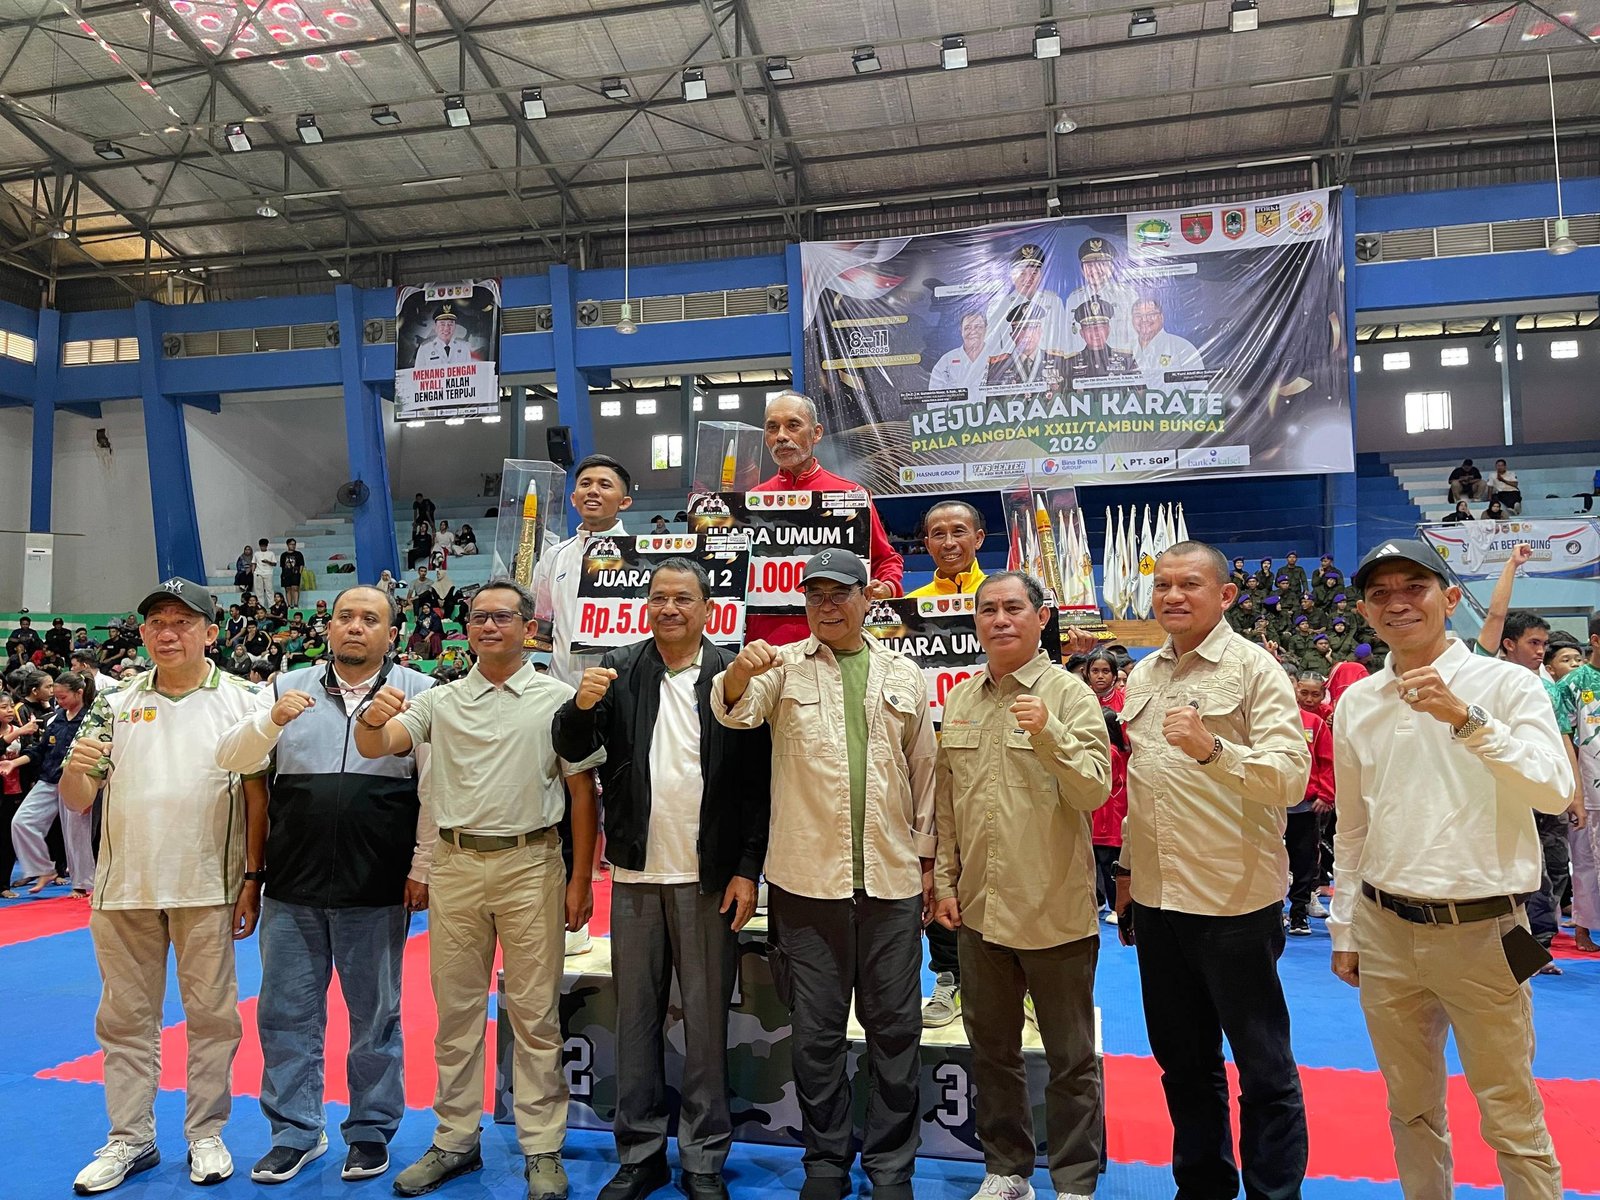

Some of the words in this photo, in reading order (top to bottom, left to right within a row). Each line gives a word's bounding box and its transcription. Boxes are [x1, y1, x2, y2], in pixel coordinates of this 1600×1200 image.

[850, 348, 870, 356] APRIL
[413, 368, 445, 381] MENANG
[447, 365, 477, 376] DENGAN
[446, 377, 470, 389] KALAH
[414, 391, 443, 403] DENGAN
[446, 387, 476, 400] TERPUJI
[912, 395, 1091, 436] KEJUARAAN
[1102, 392, 1223, 415] KARATE
[911, 437, 957, 453] PIALA
[962, 424, 1040, 445] PANGDAM
[1045, 420, 1154, 436] XXII/TAMBUN
[1159, 419, 1225, 433] BUNGAI
[1049, 435, 1096, 453] 2026
[992, 461, 1025, 471] CENTER
[1130, 458, 1146, 466] PT.
[1149, 457, 1170, 465] SGP
[1187, 458, 1209, 467] bank
[776, 527, 841, 545] UMUM
[846, 526, 854, 544] 1
[593, 569, 651, 588] JUARA
[719, 569, 732, 587] 2
[880, 635, 948, 657] UARA
[952, 634, 986, 655] UM
[563, 1036, 590, 1095] 2
[936, 1063, 968, 1126] 3
